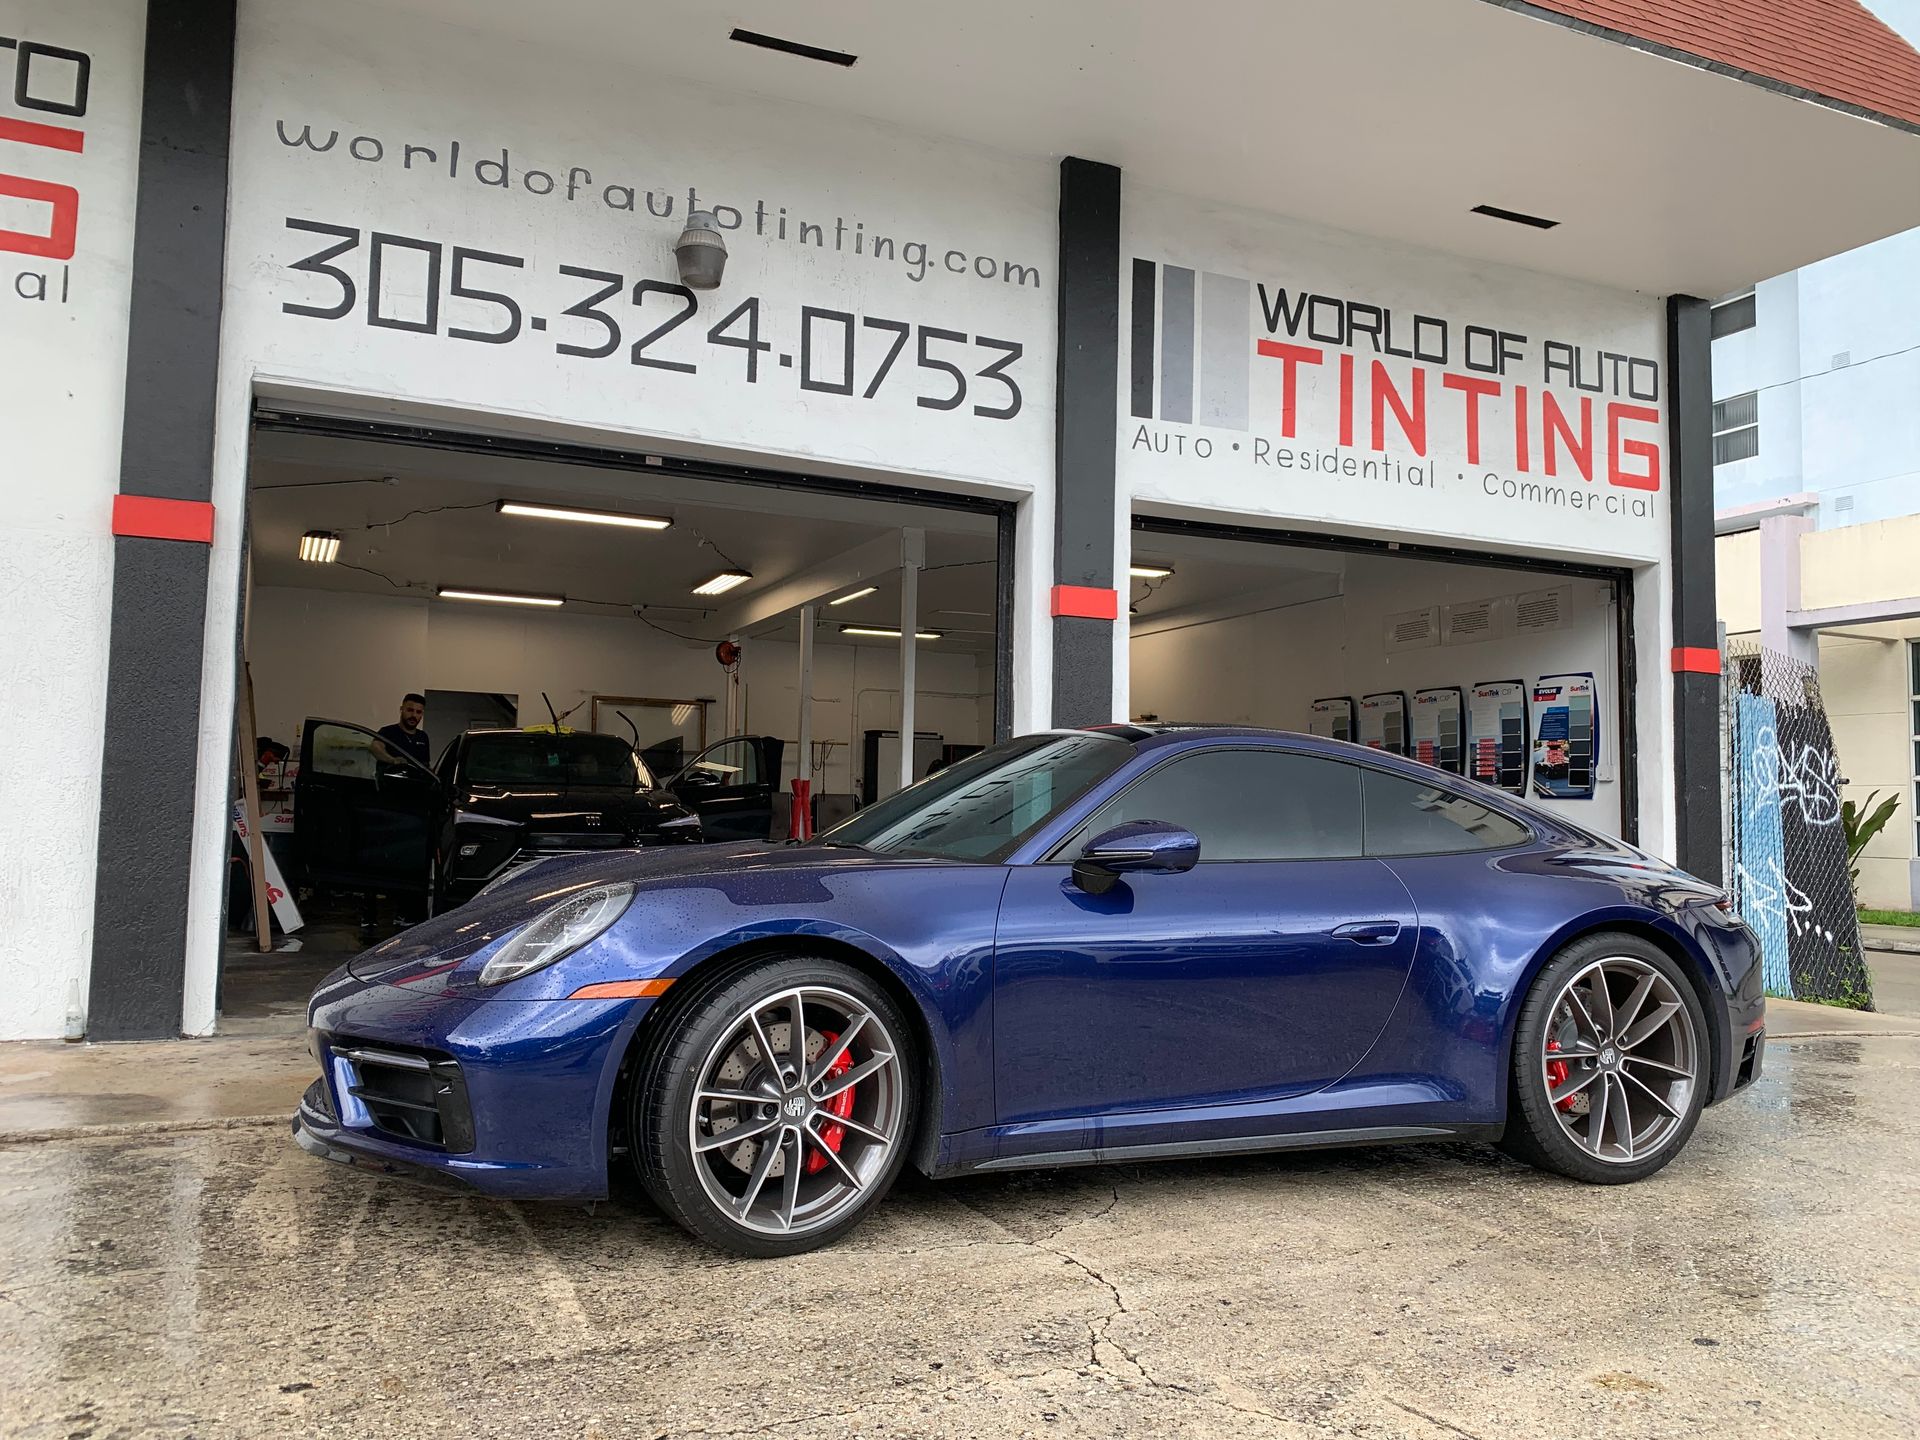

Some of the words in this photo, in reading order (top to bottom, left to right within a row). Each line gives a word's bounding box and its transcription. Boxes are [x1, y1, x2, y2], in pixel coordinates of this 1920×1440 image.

[276, 119, 1041, 288] worldofautotinting.com
[1257, 282, 1448, 365] WORLD
[1464, 324, 1528, 375] OF
[1543, 340, 1659, 403] AUTO
[1257, 338, 1660, 492] TINTING
[1255, 437, 1435, 489] Residential
[1482, 472, 1655, 519] Commercial
[1478, 689, 1499, 697] SunTek
